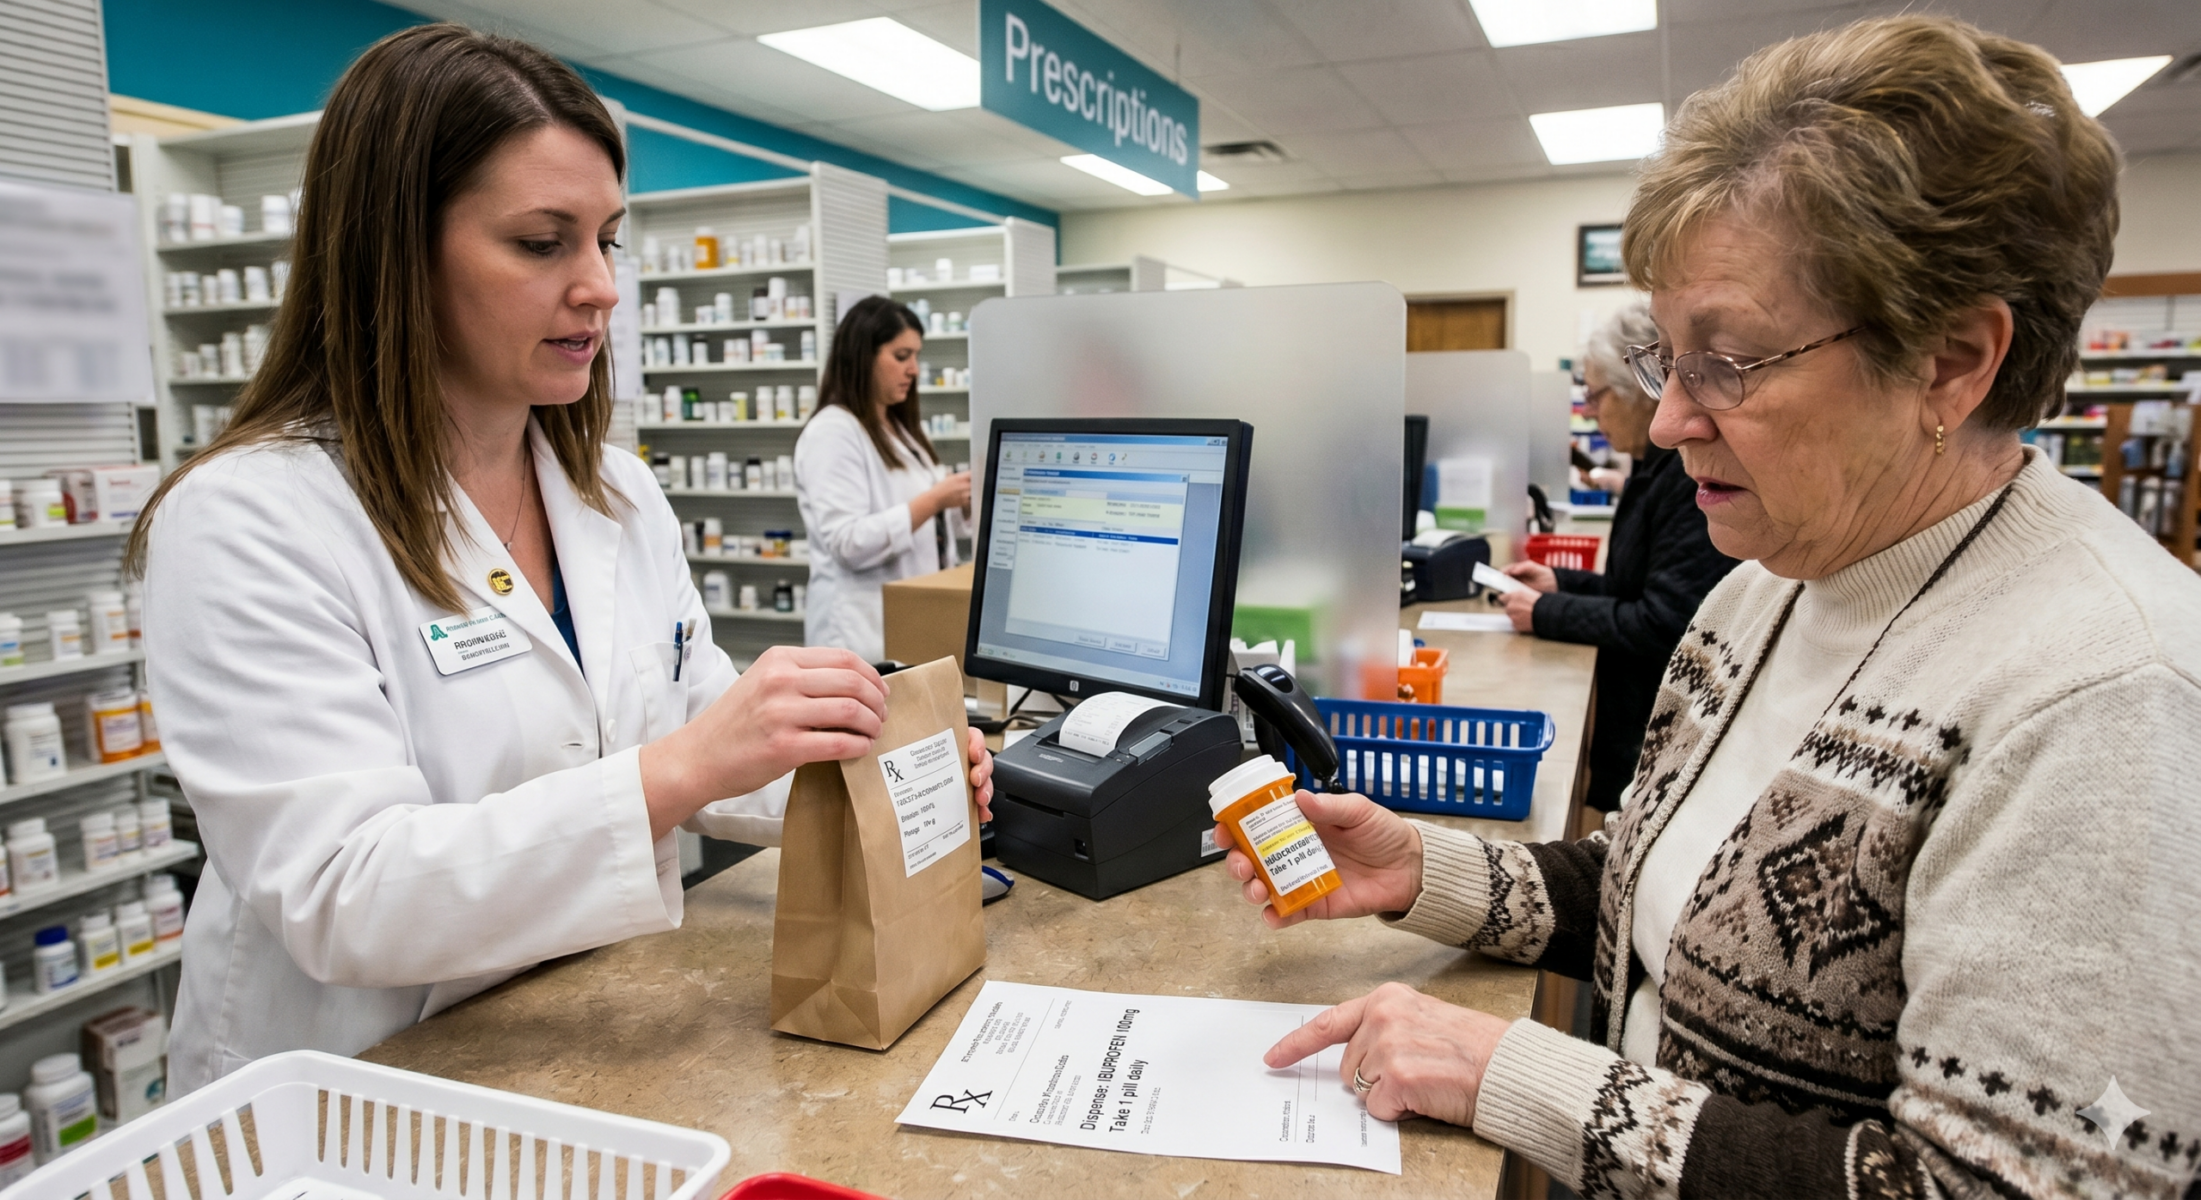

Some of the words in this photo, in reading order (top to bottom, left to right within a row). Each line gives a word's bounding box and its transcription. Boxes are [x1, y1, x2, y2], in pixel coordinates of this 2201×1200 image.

[1005, 12, 1188, 166] Prescriptions
[1079, 1085, 1110, 1131] Dispense:
[1097, 1035, 1128, 1082] IBUPROFEN
[1116, 1008, 1141, 1032] 100mg
[1127, 1059, 1149, 1081] daily
[1121, 1082, 1139, 1098] pill
[1108, 1108, 1131, 1133] Take
